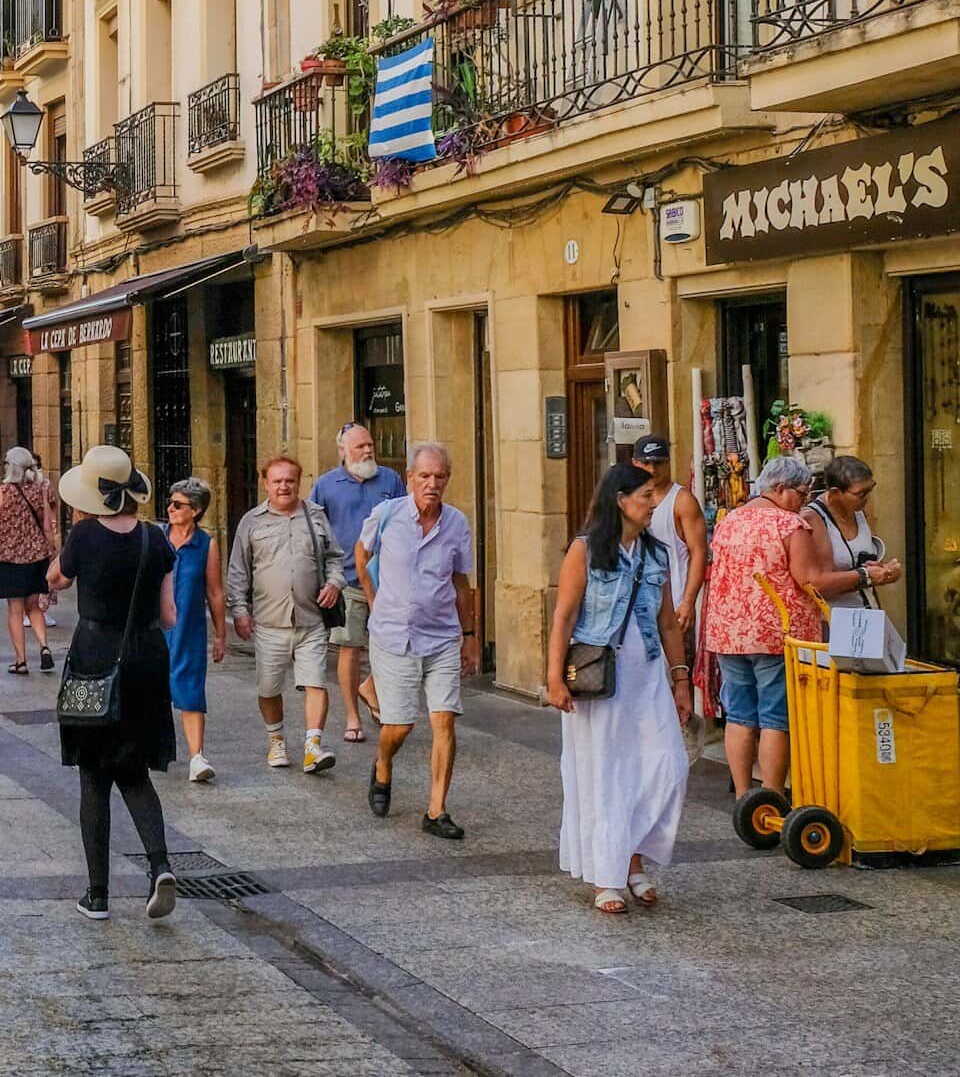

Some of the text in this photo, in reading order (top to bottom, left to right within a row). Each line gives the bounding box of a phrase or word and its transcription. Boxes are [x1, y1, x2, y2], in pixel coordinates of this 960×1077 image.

[719, 145, 949, 241] MICHAEL'S
[41, 317, 113, 351] LA CEPA DE BERNARDO
